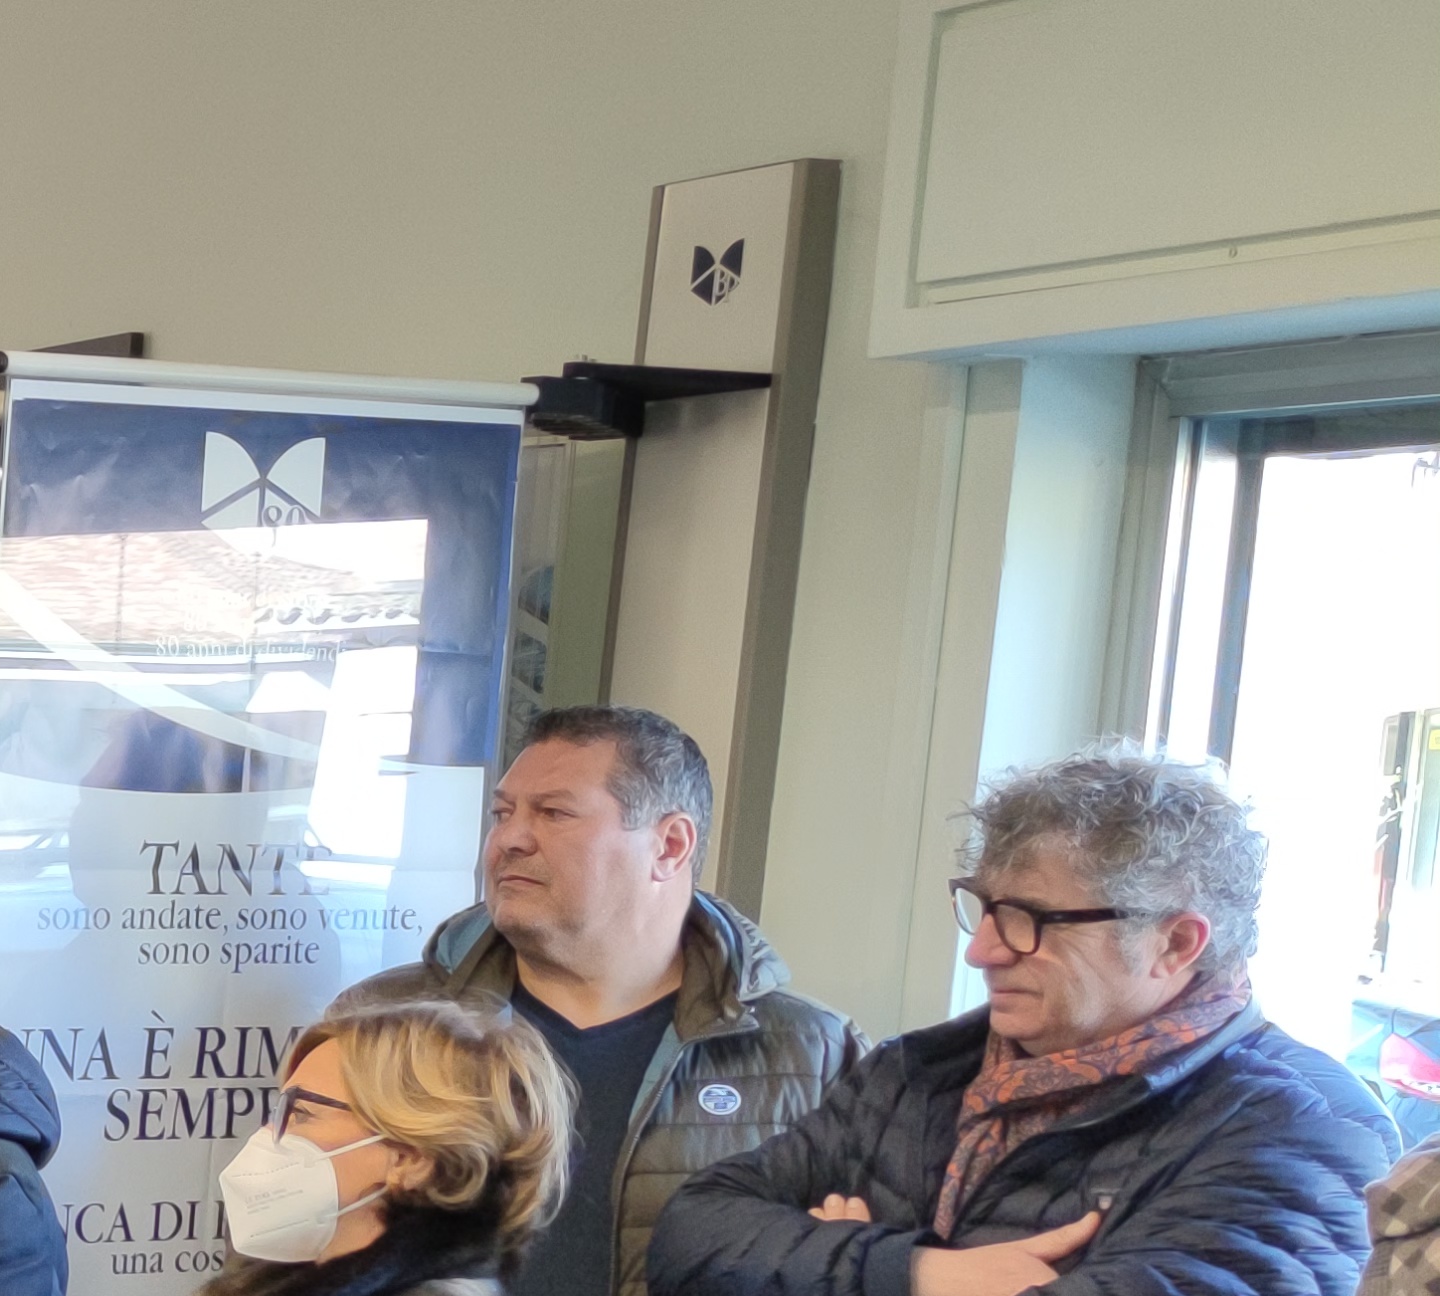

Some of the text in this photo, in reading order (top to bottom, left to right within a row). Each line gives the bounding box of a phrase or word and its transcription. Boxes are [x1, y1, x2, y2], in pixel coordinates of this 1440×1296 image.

[139, 839, 333, 897] TANTE
[37, 900, 423, 937] sono andate, sono venute,
[138, 936, 320, 973] sono sparite
[20, 1027, 121, 1081] NA
[138, 1010, 175, 1080] È
[148, 1201, 202, 1242] DI
[111, 1251, 164, 1275] una
